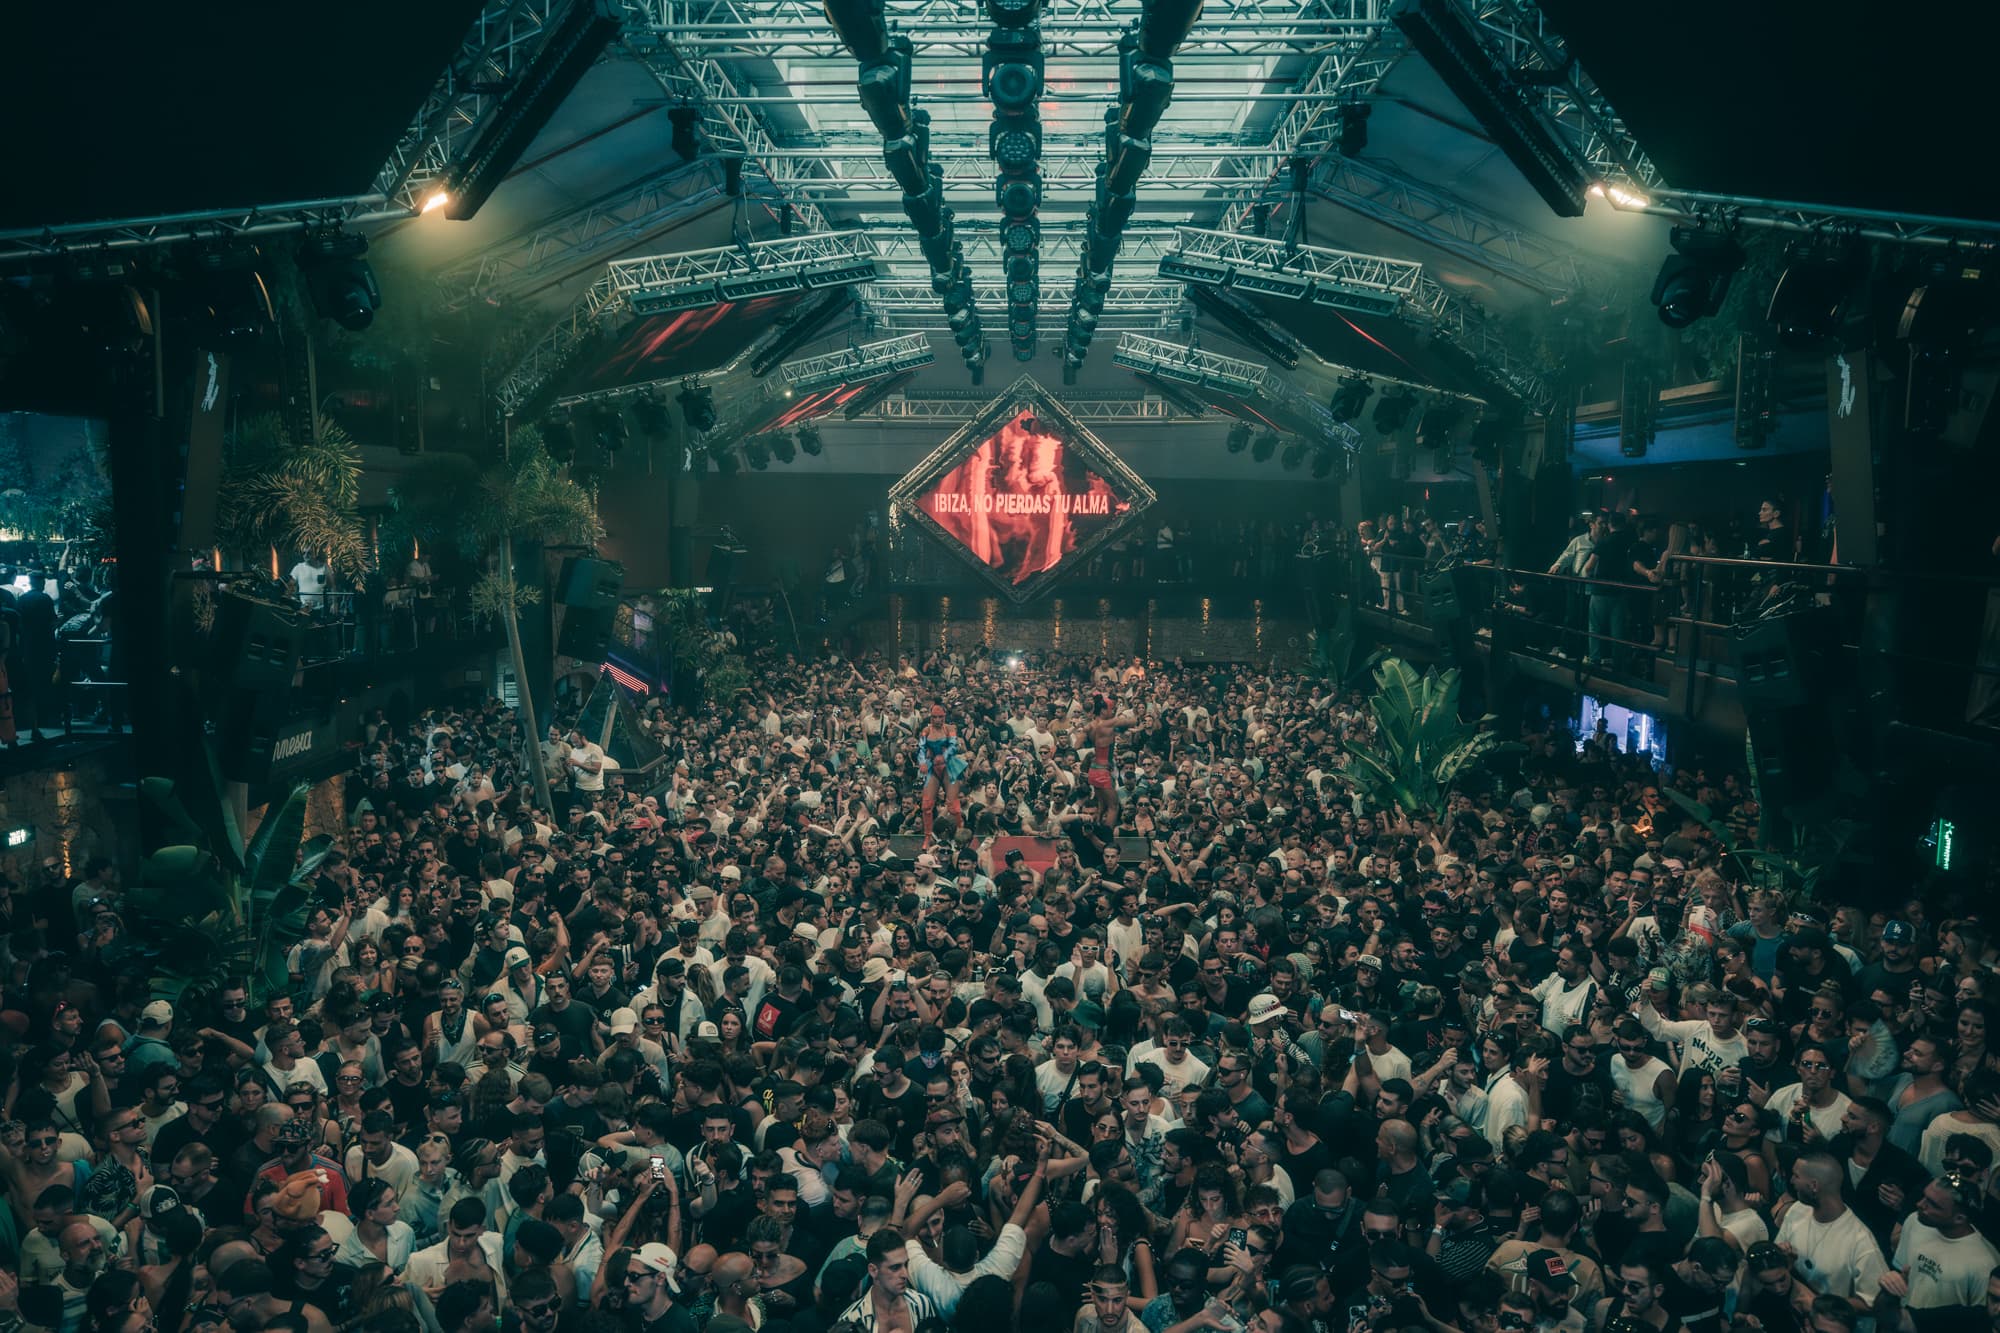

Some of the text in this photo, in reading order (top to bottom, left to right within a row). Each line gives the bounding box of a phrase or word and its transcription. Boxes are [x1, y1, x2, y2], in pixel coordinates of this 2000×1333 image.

[934, 494, 1109, 516] IBIZA, NO PIERDAS TU ALMA
[271, 730, 313, 762] nesia
